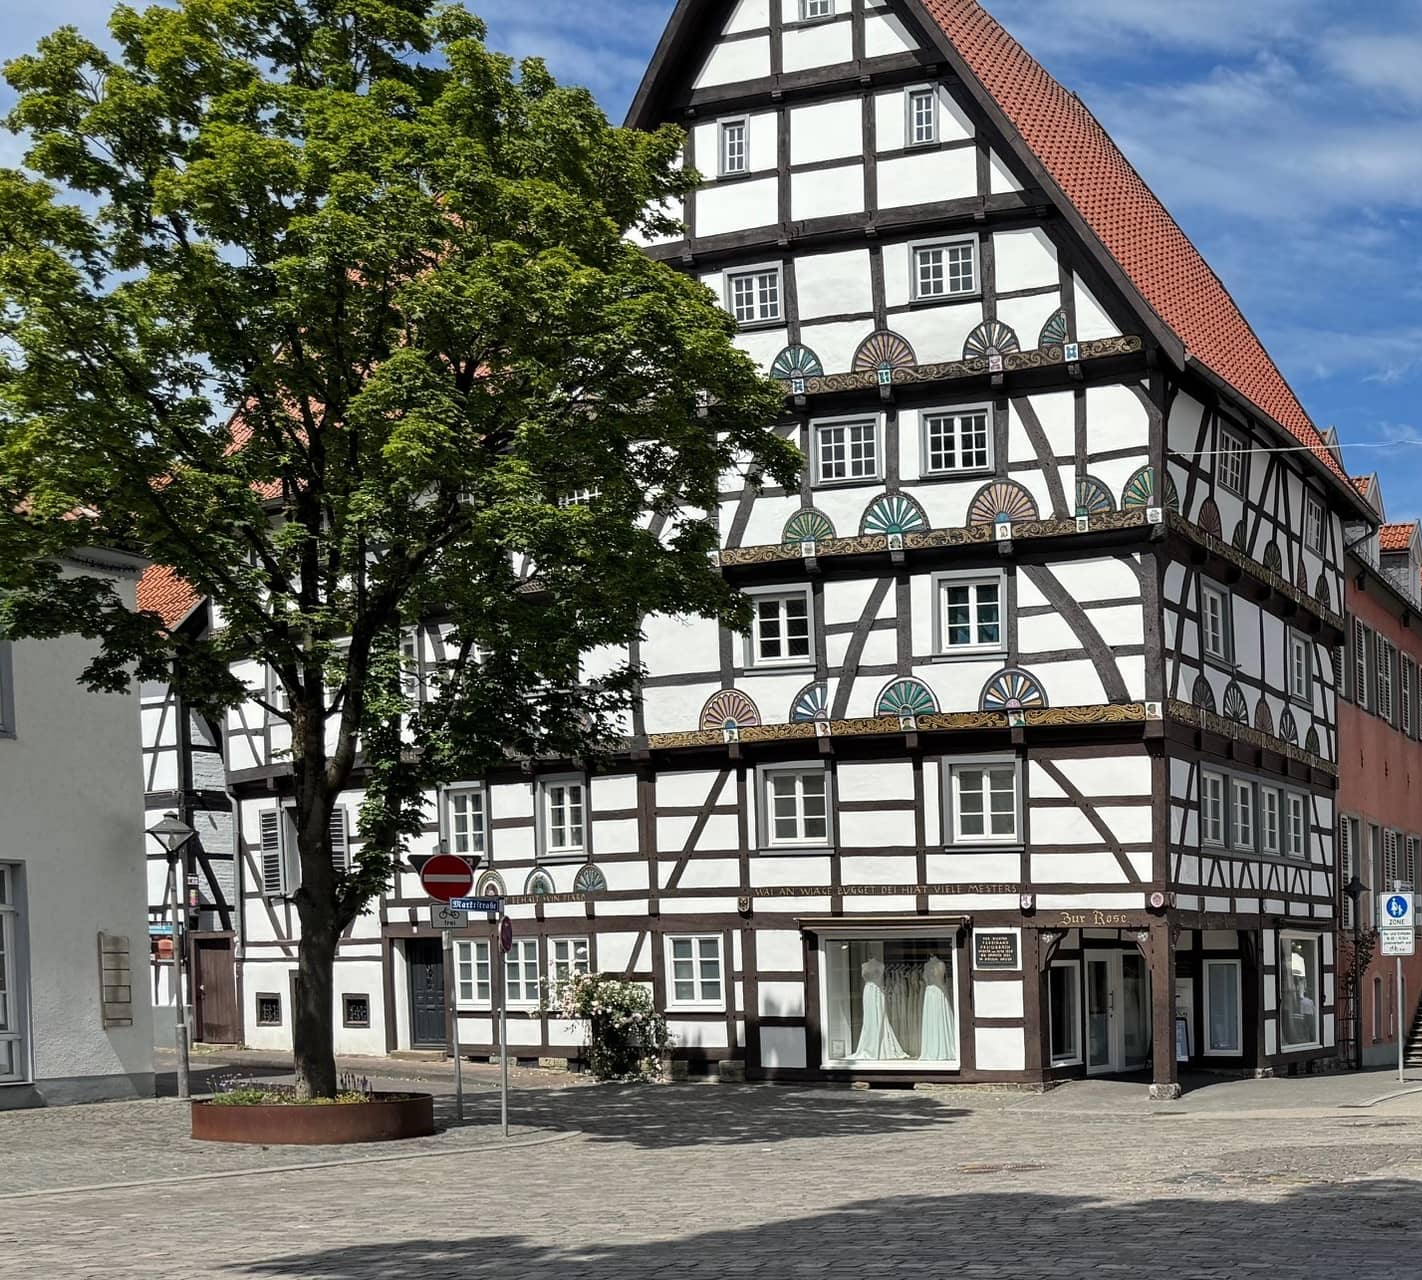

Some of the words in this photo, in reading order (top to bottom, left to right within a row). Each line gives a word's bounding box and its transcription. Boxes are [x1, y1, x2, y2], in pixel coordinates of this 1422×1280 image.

[779, 887, 795, 896] AN
[934, 884, 961, 894] VIELE
[967, 884, 1017, 894] MESTERS
[452, 900, 497, 910] Marktstraße
[1060, 911, 1086, 925] Zur
[1092, 910, 1129, 925] Rose
